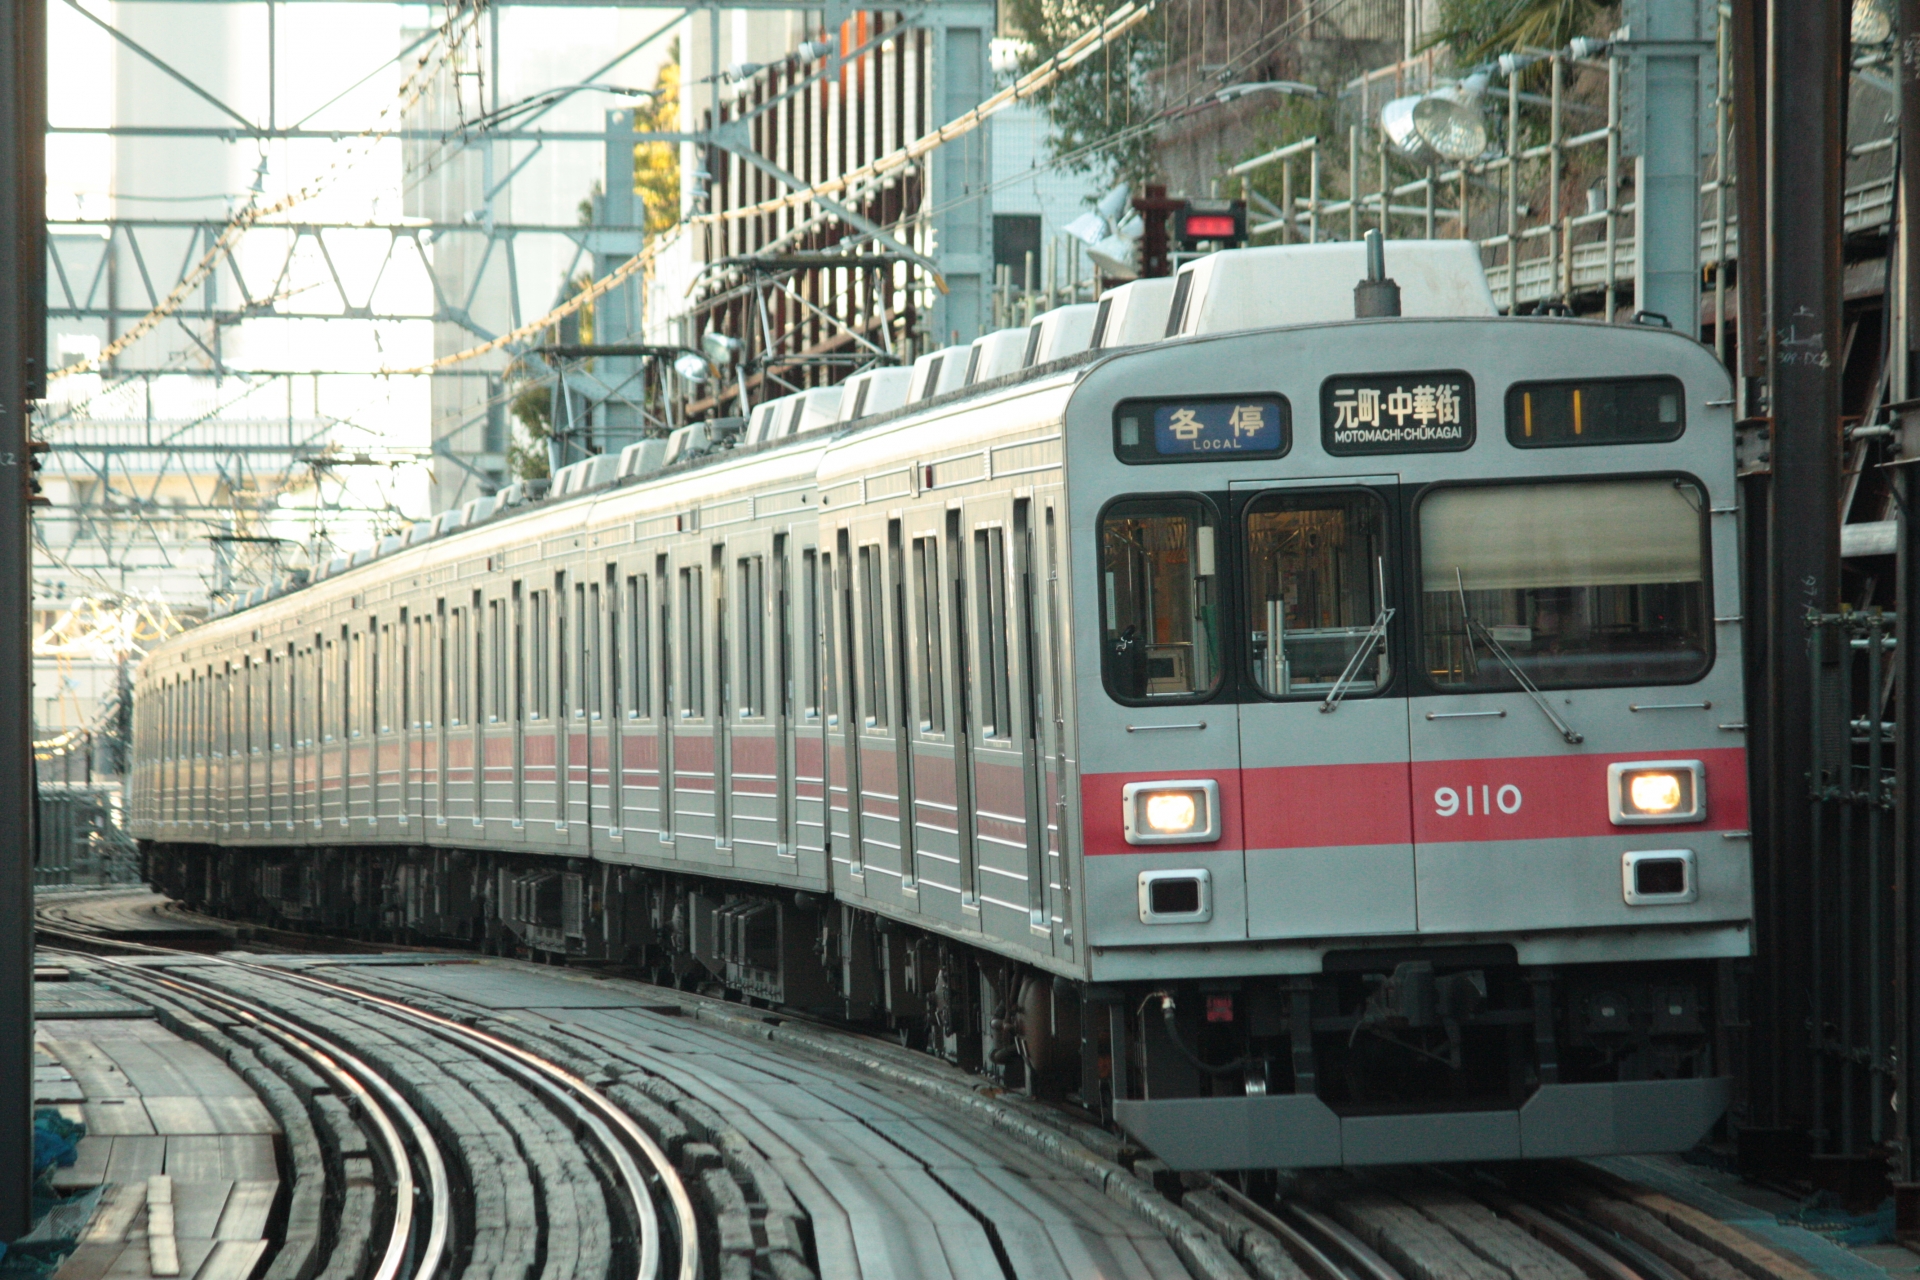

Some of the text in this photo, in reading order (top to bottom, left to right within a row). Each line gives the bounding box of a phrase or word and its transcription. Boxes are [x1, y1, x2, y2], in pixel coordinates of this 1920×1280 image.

[1169, 405, 1264, 440] 各停
[1333, 384, 1460, 429] 元町・中華街
[1193, 438, 1242, 450] LOCAL
[1435, 784, 1522, 817] 9110
